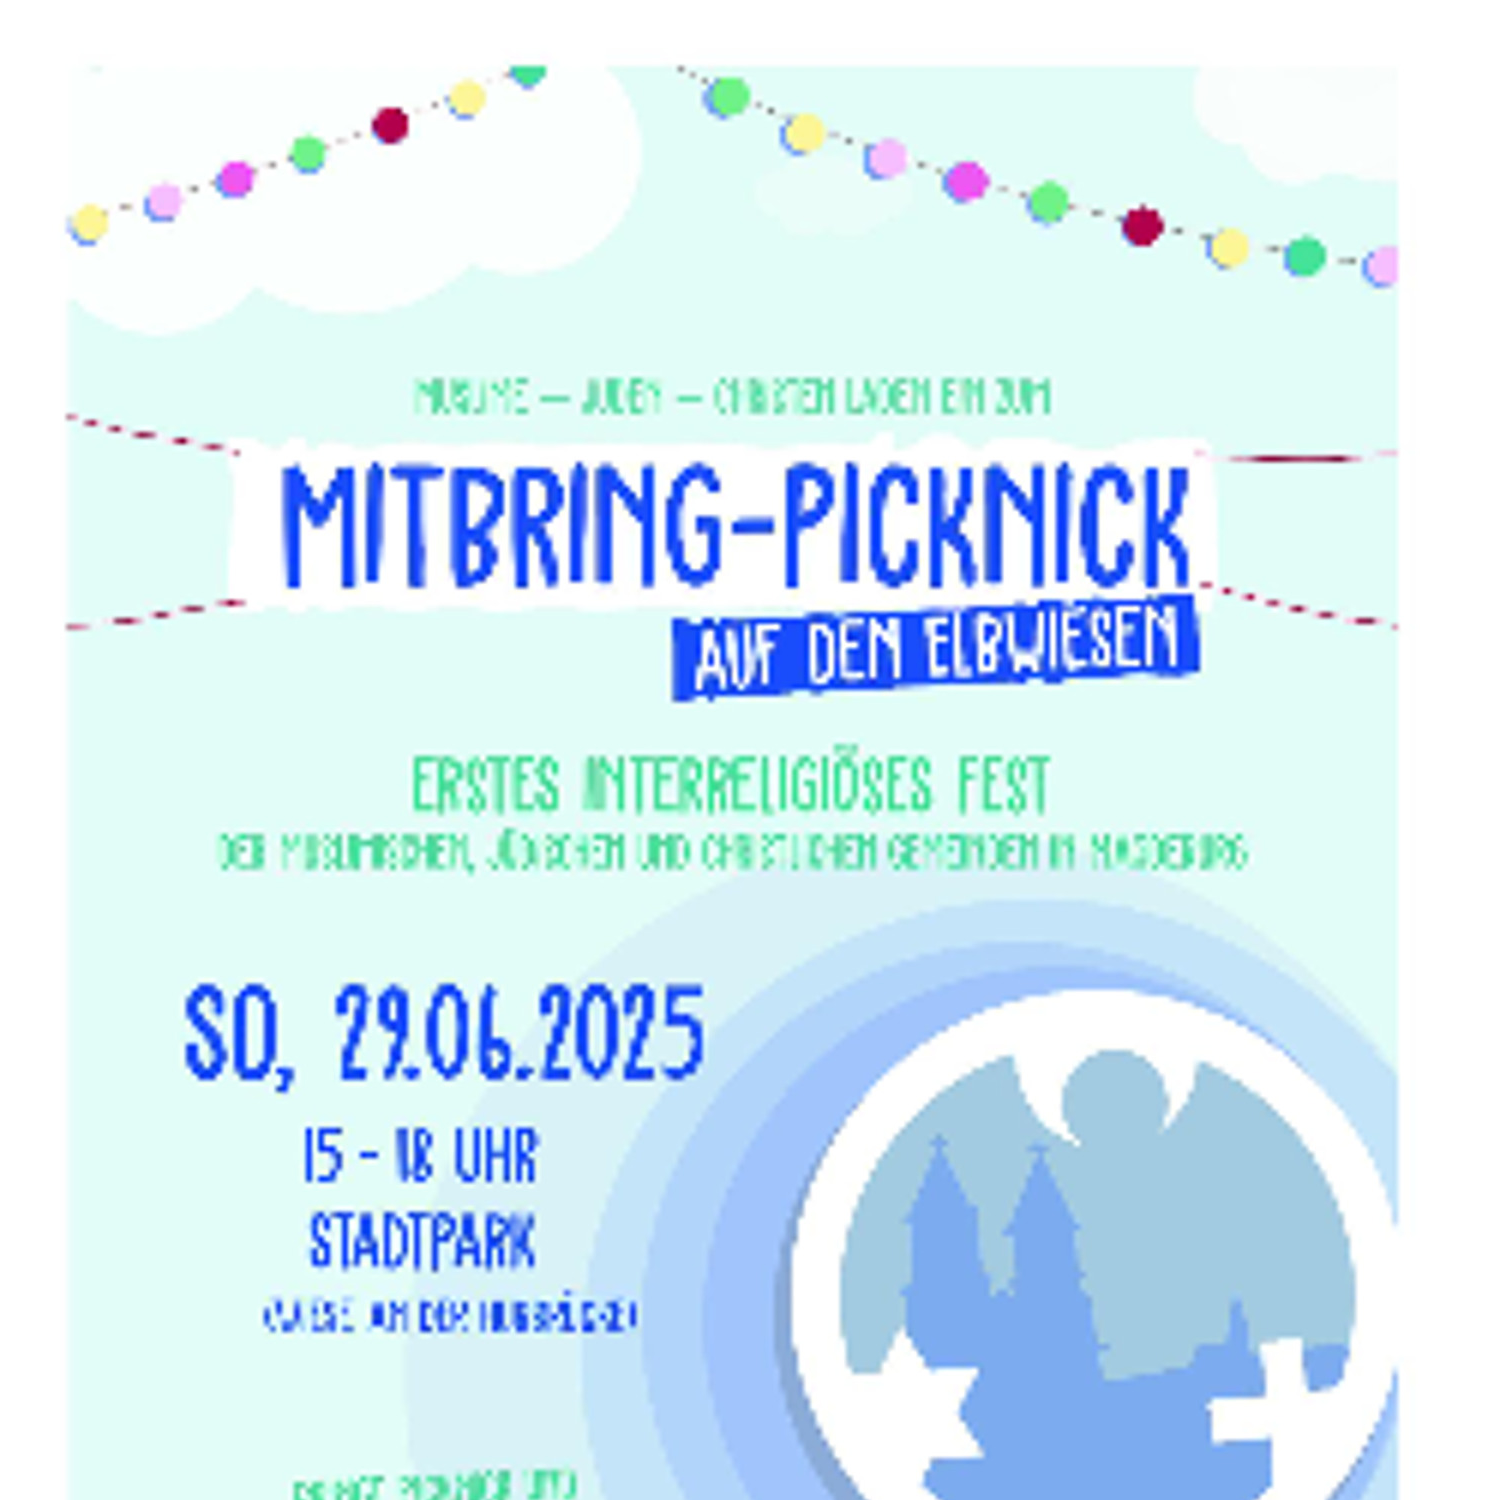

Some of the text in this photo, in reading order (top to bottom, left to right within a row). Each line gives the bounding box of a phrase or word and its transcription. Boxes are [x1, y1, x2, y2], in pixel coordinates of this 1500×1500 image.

[282, 461, 1194, 588] MITBRING-PICKNICK
[695, 604, 1179, 691] AUF DEN ELBWIESEN
[412, 743, 1052, 817] ERSTES INTERRELIGIÖSES FEST
[184, 983, 704, 1093] SO, 29.06.2025
[304, 1127, 344, 1184] 15
[395, 1127, 434, 1184] 18
[455, 1127, 540, 1184] UHR
[308, 1211, 536, 1273] STADTPARK
